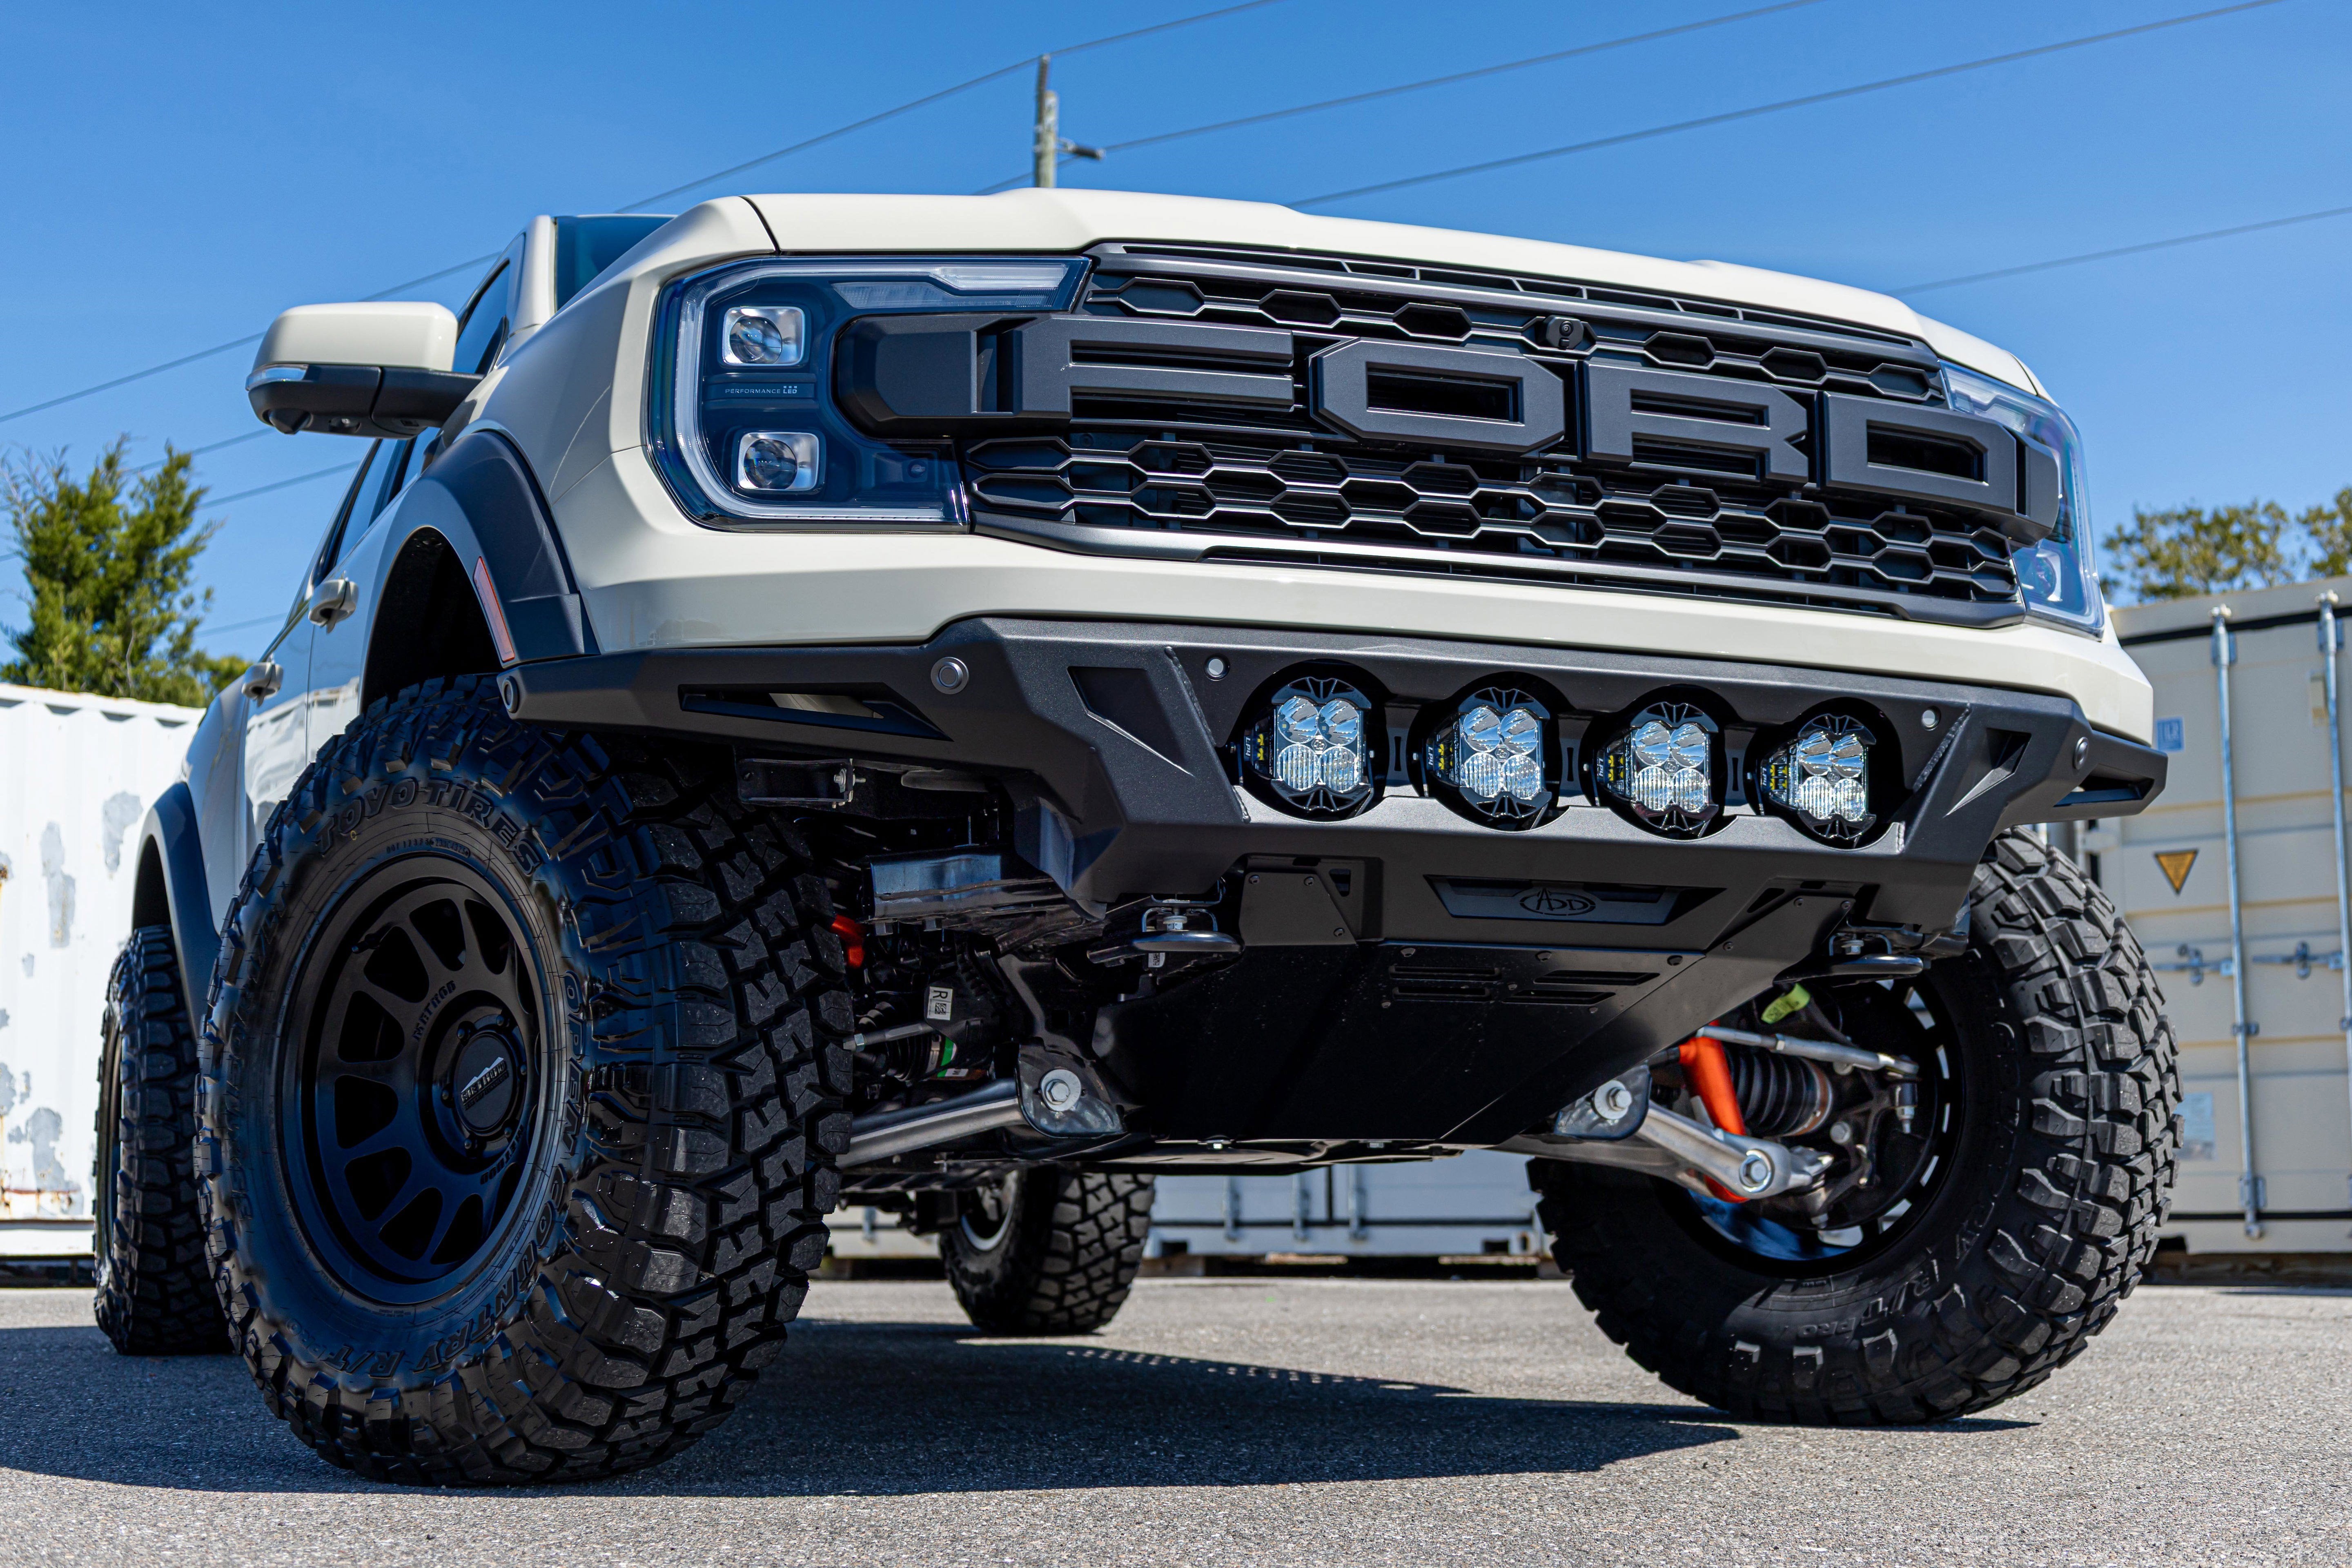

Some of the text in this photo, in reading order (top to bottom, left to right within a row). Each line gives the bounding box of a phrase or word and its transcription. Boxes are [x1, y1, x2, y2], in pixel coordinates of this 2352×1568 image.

[1017, 314, 2017, 517] FORD
[315, 777, 542, 877] TOYO TIRES
[412, 980, 457, 1042] METHOD
[562, 970, 587, 1156] OPEN
[412, 1164, 568, 1374] COUNTRY
